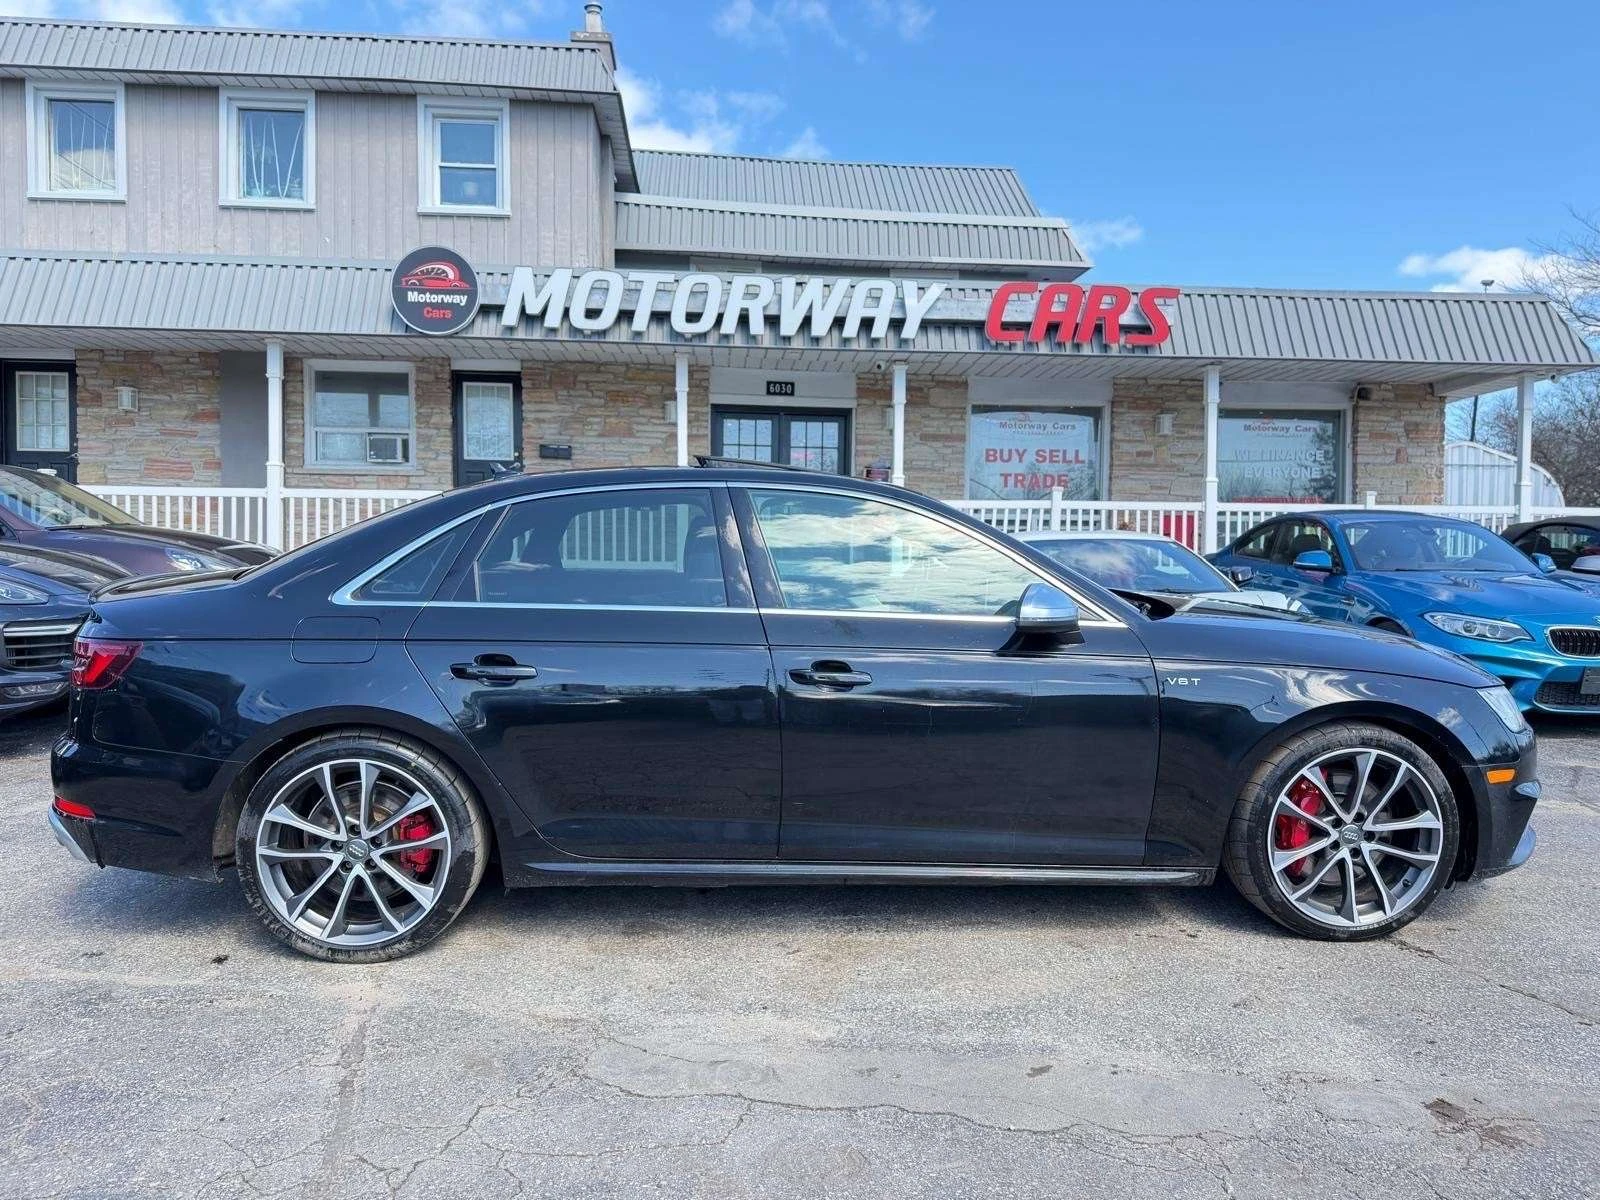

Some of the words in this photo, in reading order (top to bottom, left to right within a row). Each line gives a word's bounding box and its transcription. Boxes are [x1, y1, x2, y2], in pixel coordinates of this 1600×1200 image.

[407, 291, 467, 306] Motorway
[501, 266, 948, 340] MOTORWAY
[985, 281, 1181, 345] CARS
[424, 307, 452, 319] Cars
[769, 383, 793, 394] 6030
[999, 421, 1047, 431] Motorway
[1052, 422, 1076, 430] Cars
[1243, 424, 1290, 433] Motorway
[1295, 424, 1318, 432] Cars
[984, 448, 1027, 463] BUY
[1035, 449, 1085, 464] SELL
[1244, 466, 1321, 478] EVERYONE
[1000, 472, 1069, 489] TRADE
